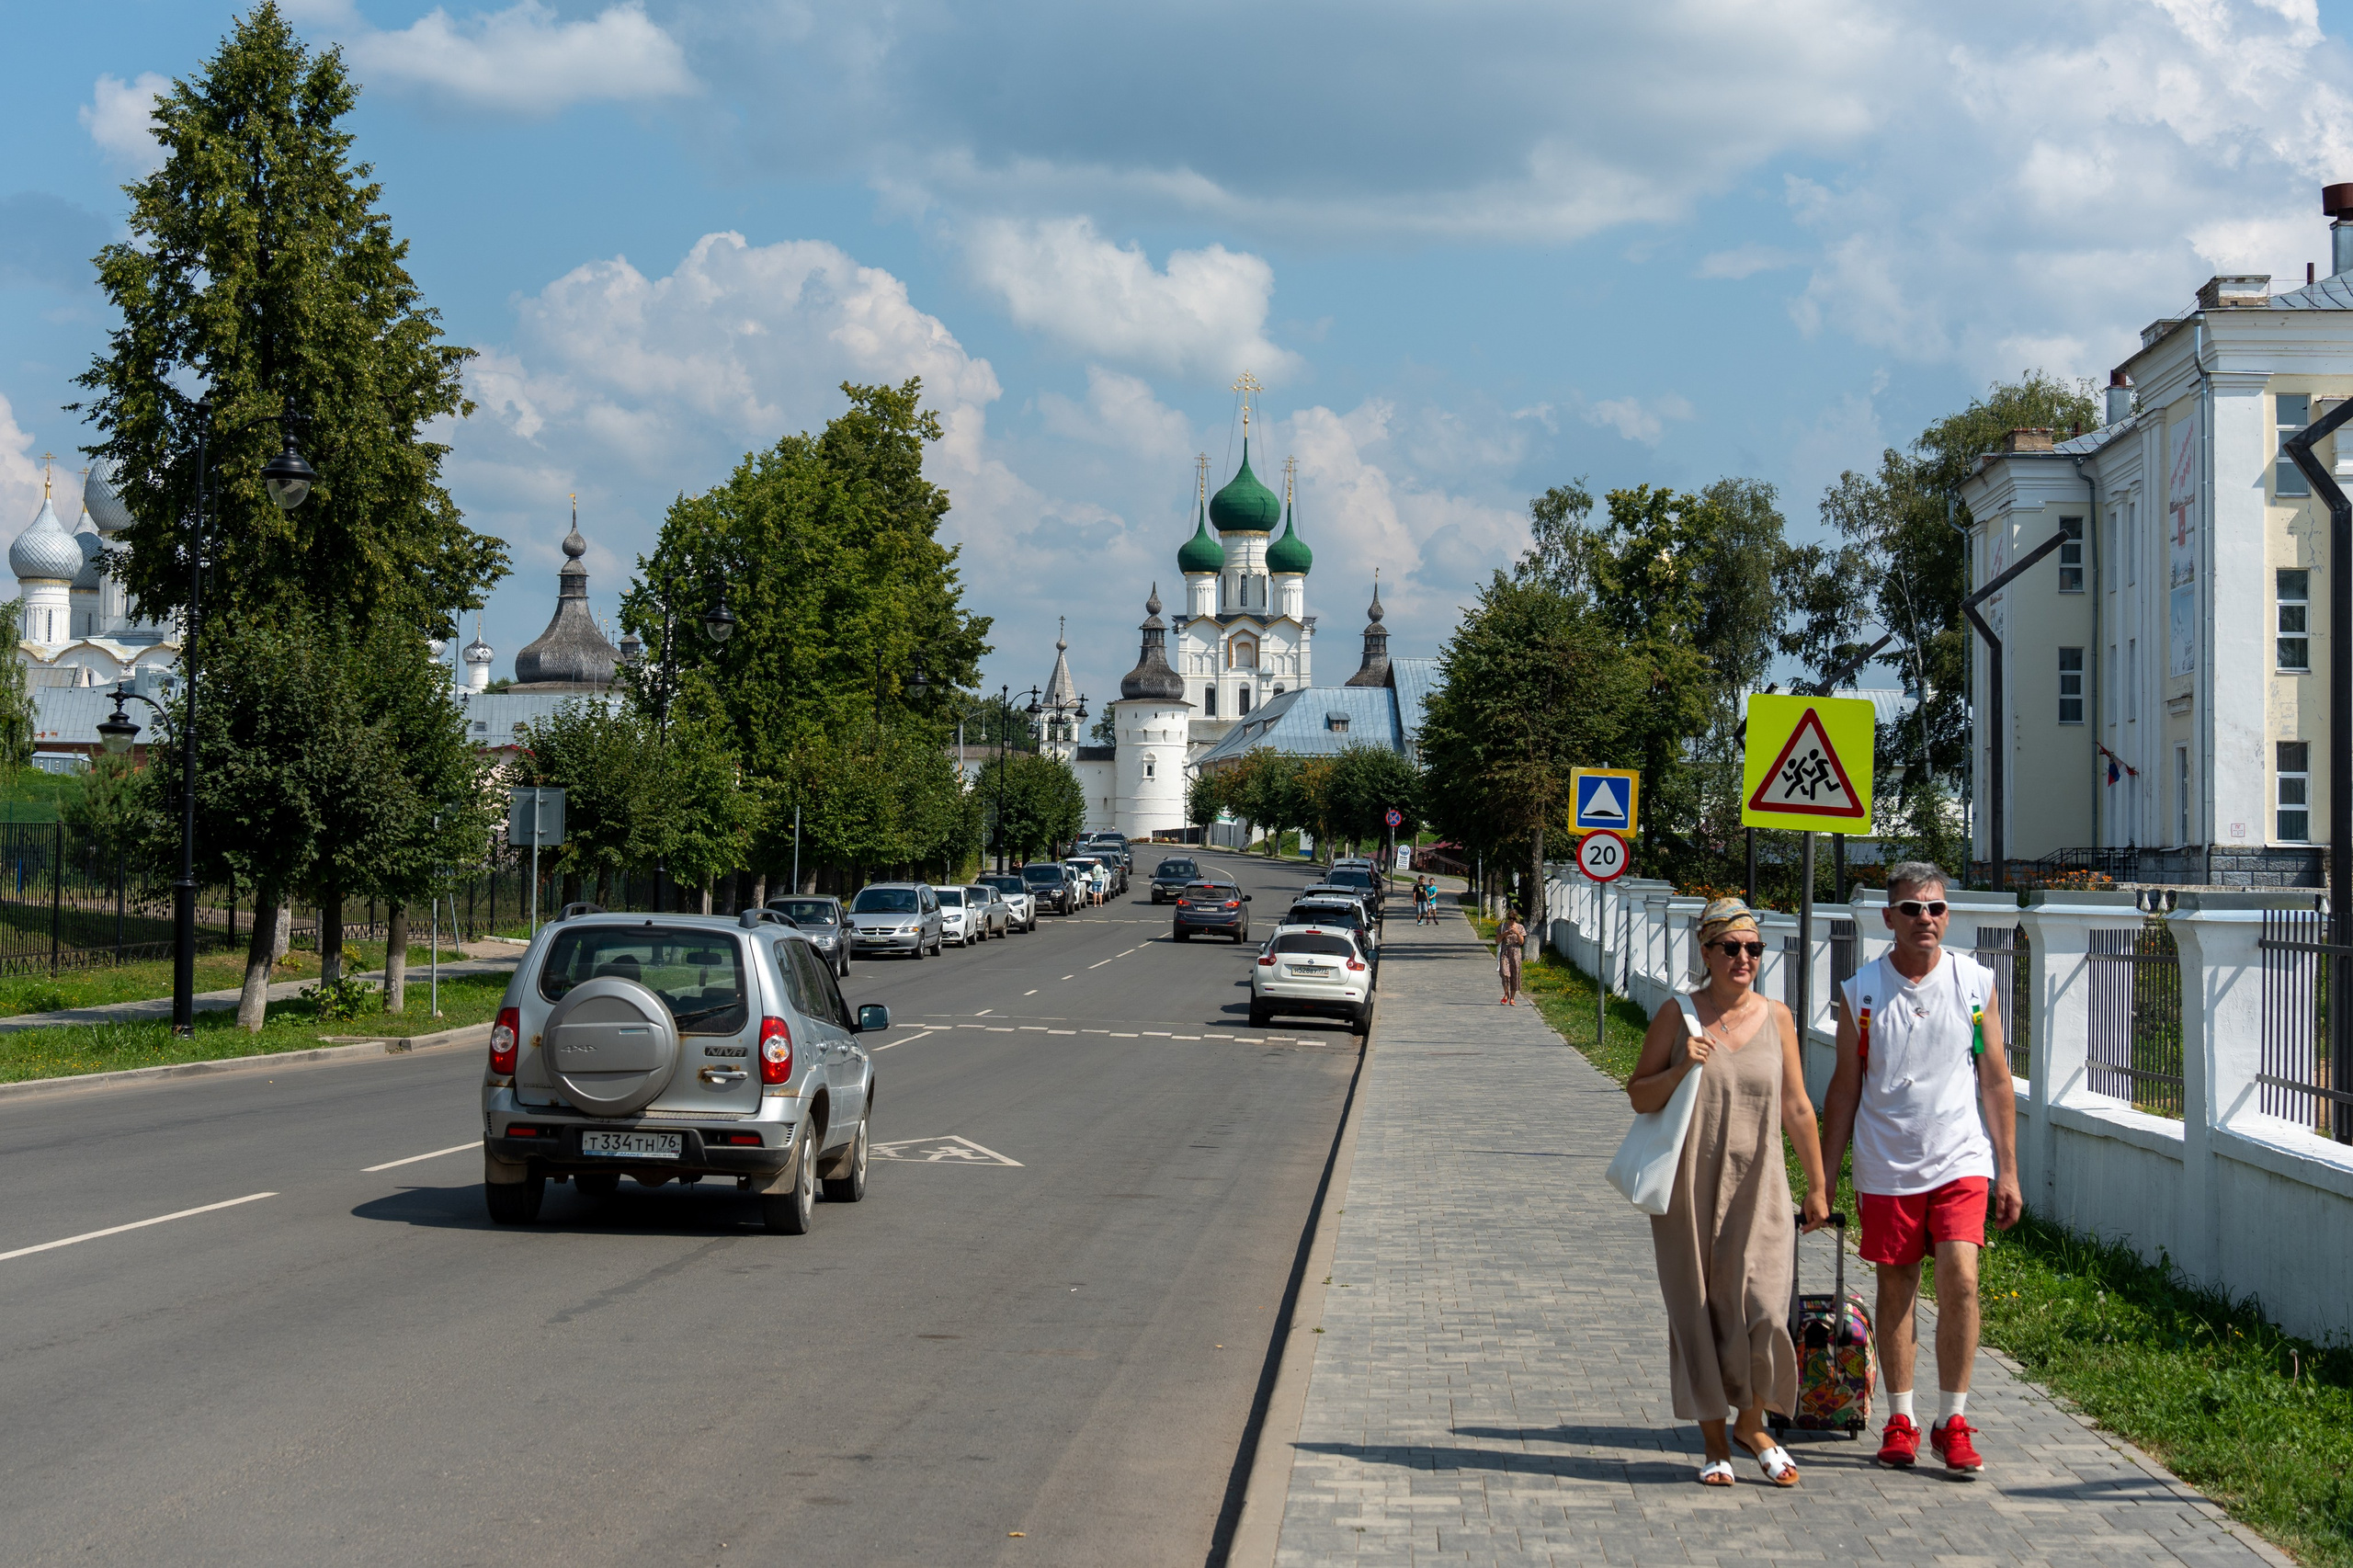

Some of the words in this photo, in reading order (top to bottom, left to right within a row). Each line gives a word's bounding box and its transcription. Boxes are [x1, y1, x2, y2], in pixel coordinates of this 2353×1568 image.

[1589, 846, 1617, 866] 20
[707, 1048, 745, 1056] NIVA
[660, 1135, 676, 1148] 76
